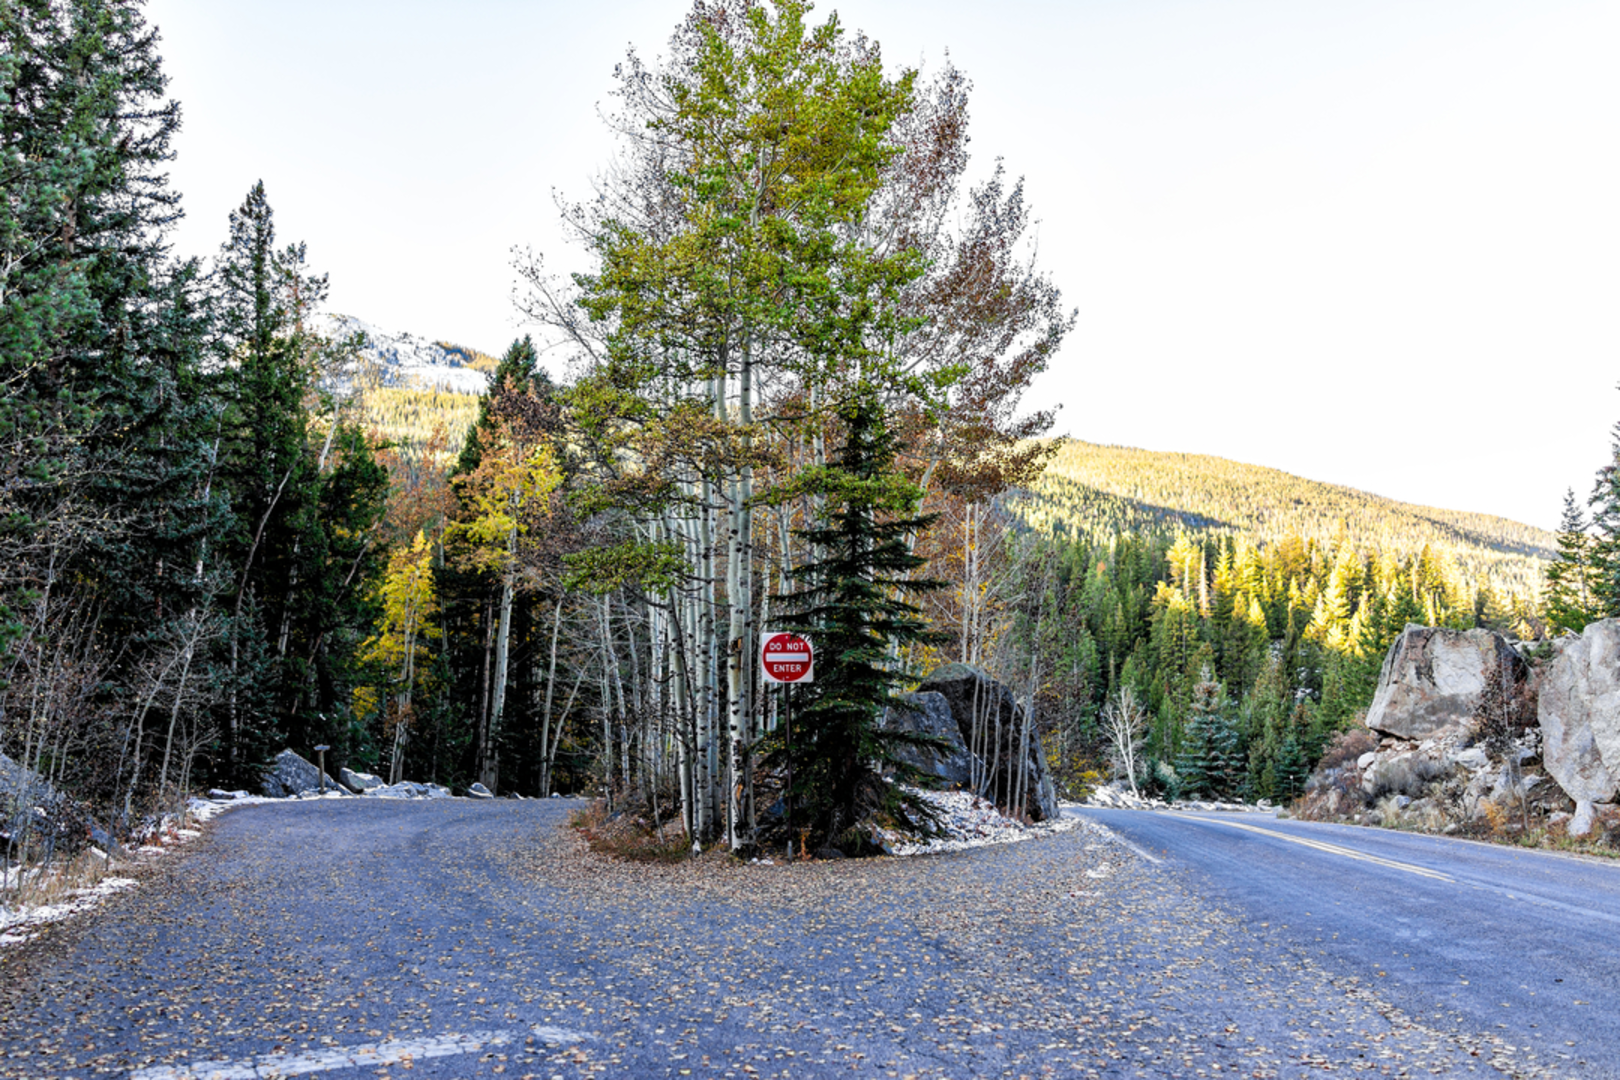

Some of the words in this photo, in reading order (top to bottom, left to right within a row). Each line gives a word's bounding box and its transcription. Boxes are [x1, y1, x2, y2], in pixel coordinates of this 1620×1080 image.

[769, 642, 782, 651] DO
[786, 642, 804, 651] NOT
[773, 664, 802, 673] ENTER
